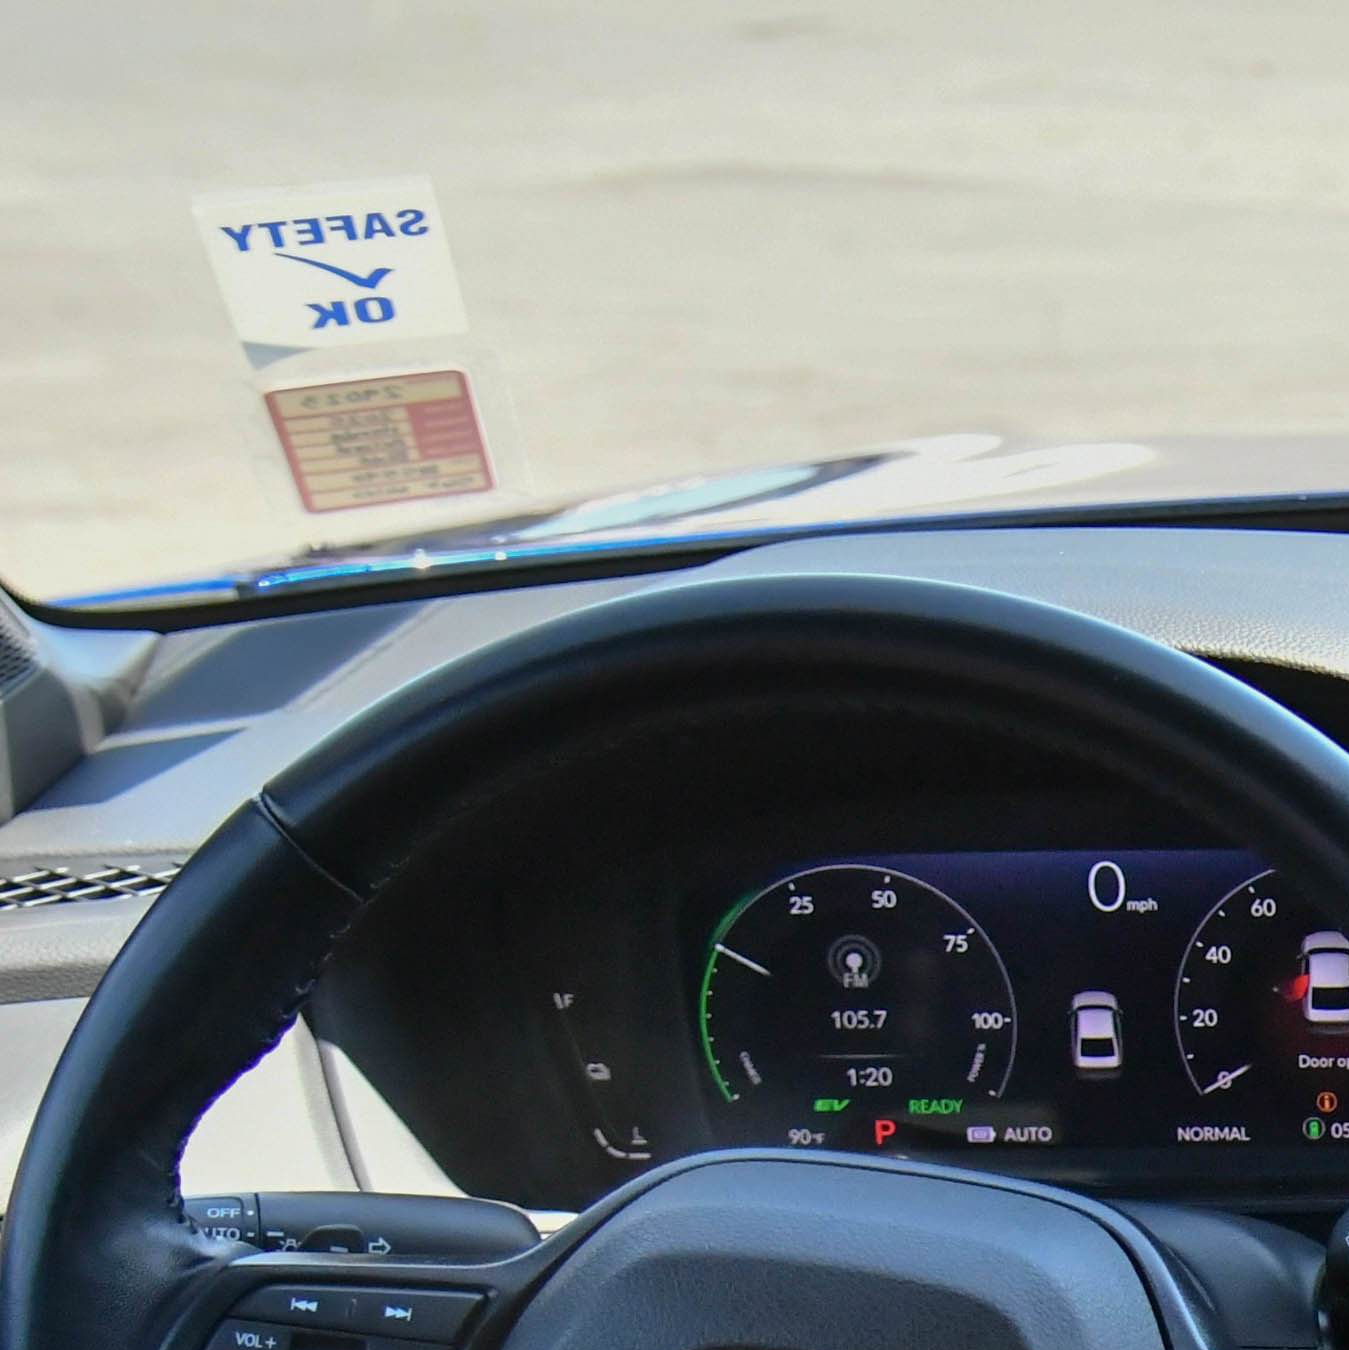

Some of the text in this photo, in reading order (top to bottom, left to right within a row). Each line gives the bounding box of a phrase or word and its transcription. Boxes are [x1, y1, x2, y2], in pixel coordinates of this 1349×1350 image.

[1088, 860, 1158, 913] 0 mph
[789, 896, 814, 914] 25
[871, 890, 897, 908] 50
[1250, 898, 1276, 917] 60
[943, 935, 968, 952] 75
[1205, 946, 1231, 965] 40
[842, 972, 869, 988] FM
[830, 1010, 888, 1030] 105.7
[971, 1012, 1003, 1030] 100
[1192, 1008, 1218, 1028] 20
[1298, 1054, 1335, 1069] Door
[847, 1067, 893, 1087] 1:20
[908, 1099, 963, 1114] READY
[874, 1119, 897, 1145] P
[1004, 1126, 1053, 1142] AUTO
[1176, 1125, 1251, 1142] NORMAL
[207, 1207, 241, 1219] OFF
